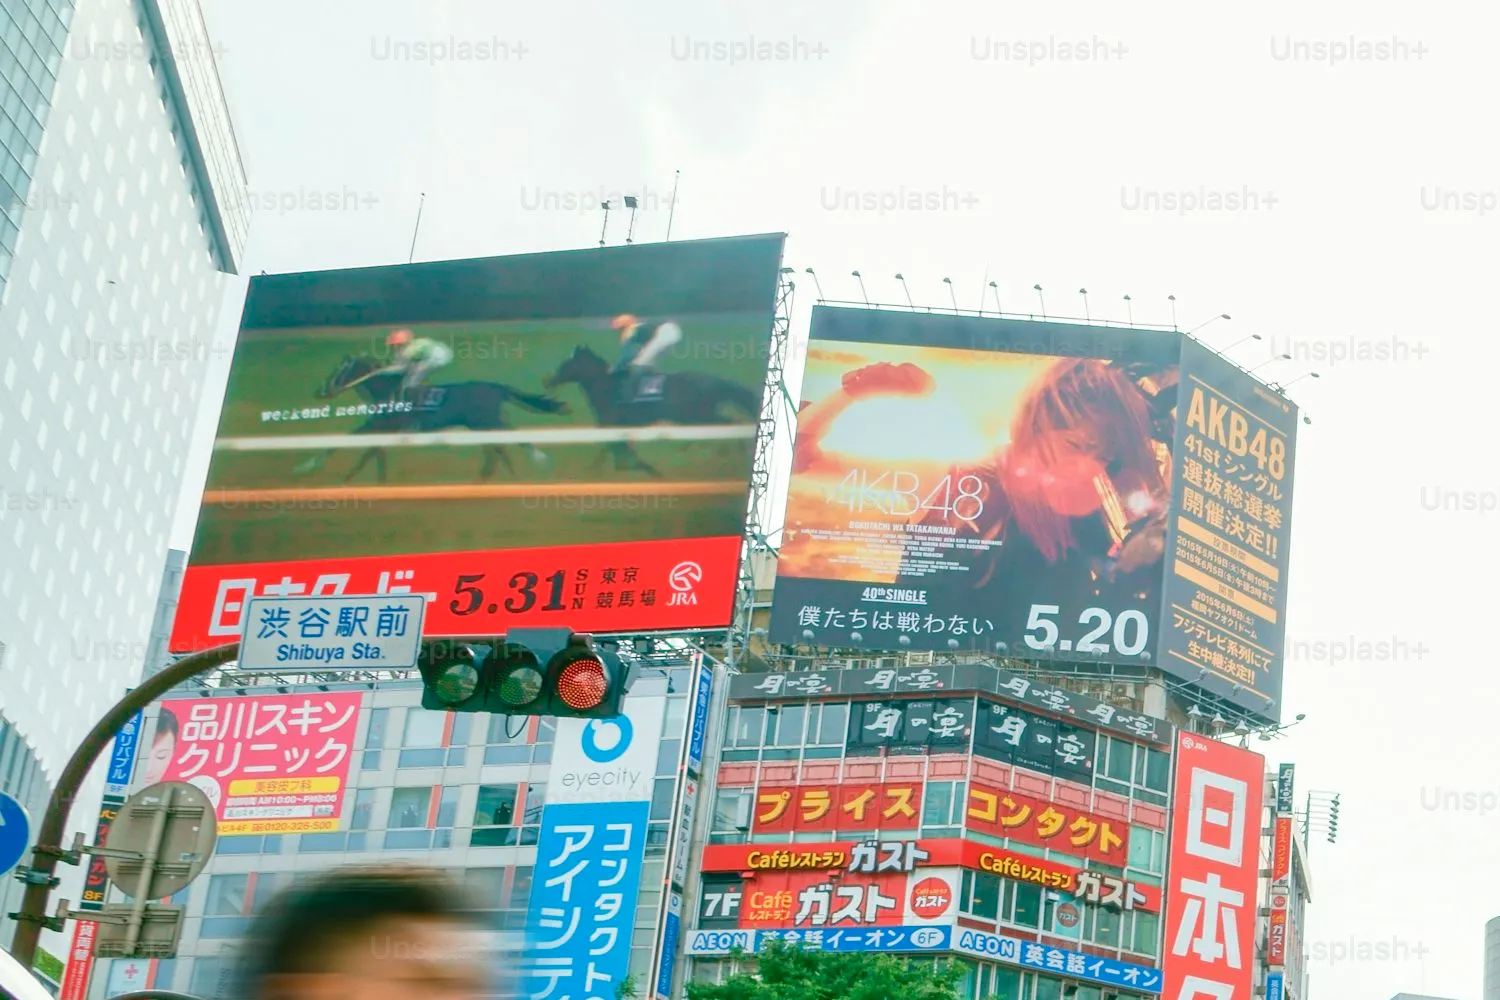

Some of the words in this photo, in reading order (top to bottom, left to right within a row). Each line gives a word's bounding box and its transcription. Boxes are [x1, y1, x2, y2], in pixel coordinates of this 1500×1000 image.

[1186, 387, 1286, 481] AKB48
[1183, 456, 1282, 530] 選抜総選挙
[571, 568, 589, 610] SUN
[600, 566, 640, 585] 東京
[450, 569, 567, 616] 5.31
[595, 589, 657, 609] 競馬場
[666, 592, 698, 606] JRA
[257, 606, 410, 639] 渋谷駅前
[797, 605, 994, 635] 僕たちは戦わない
[1023, 604, 1149, 656] 5.20
[276, 643, 344, 663] Shibuya
[351, 642, 386, 660] Sta.
[1173, 614, 1272, 673] フジテレビ系列にて
[181, 700, 356, 741] 品川スキン
[177, 737, 348, 778] クリニック
[561, 768, 641, 793] eyecity
[758, 787, 917, 824] プライス
[967, 788, 1124, 853] コンタクト
[848, 840, 931, 873] ガスト
[704, 892, 741, 917] 7F
[750, 890, 793, 910] Café
[795, 884, 897, 926] ガスト
[914, 896, 948, 908] ガスト
[1075, 871, 1147, 912] ガスト
[692, 932, 748, 951] AEON
[916, 931, 938, 945] 6F
[959, 931, 1015, 959] AEON
[1024, 943, 1159, 987] 英会話イーオン
